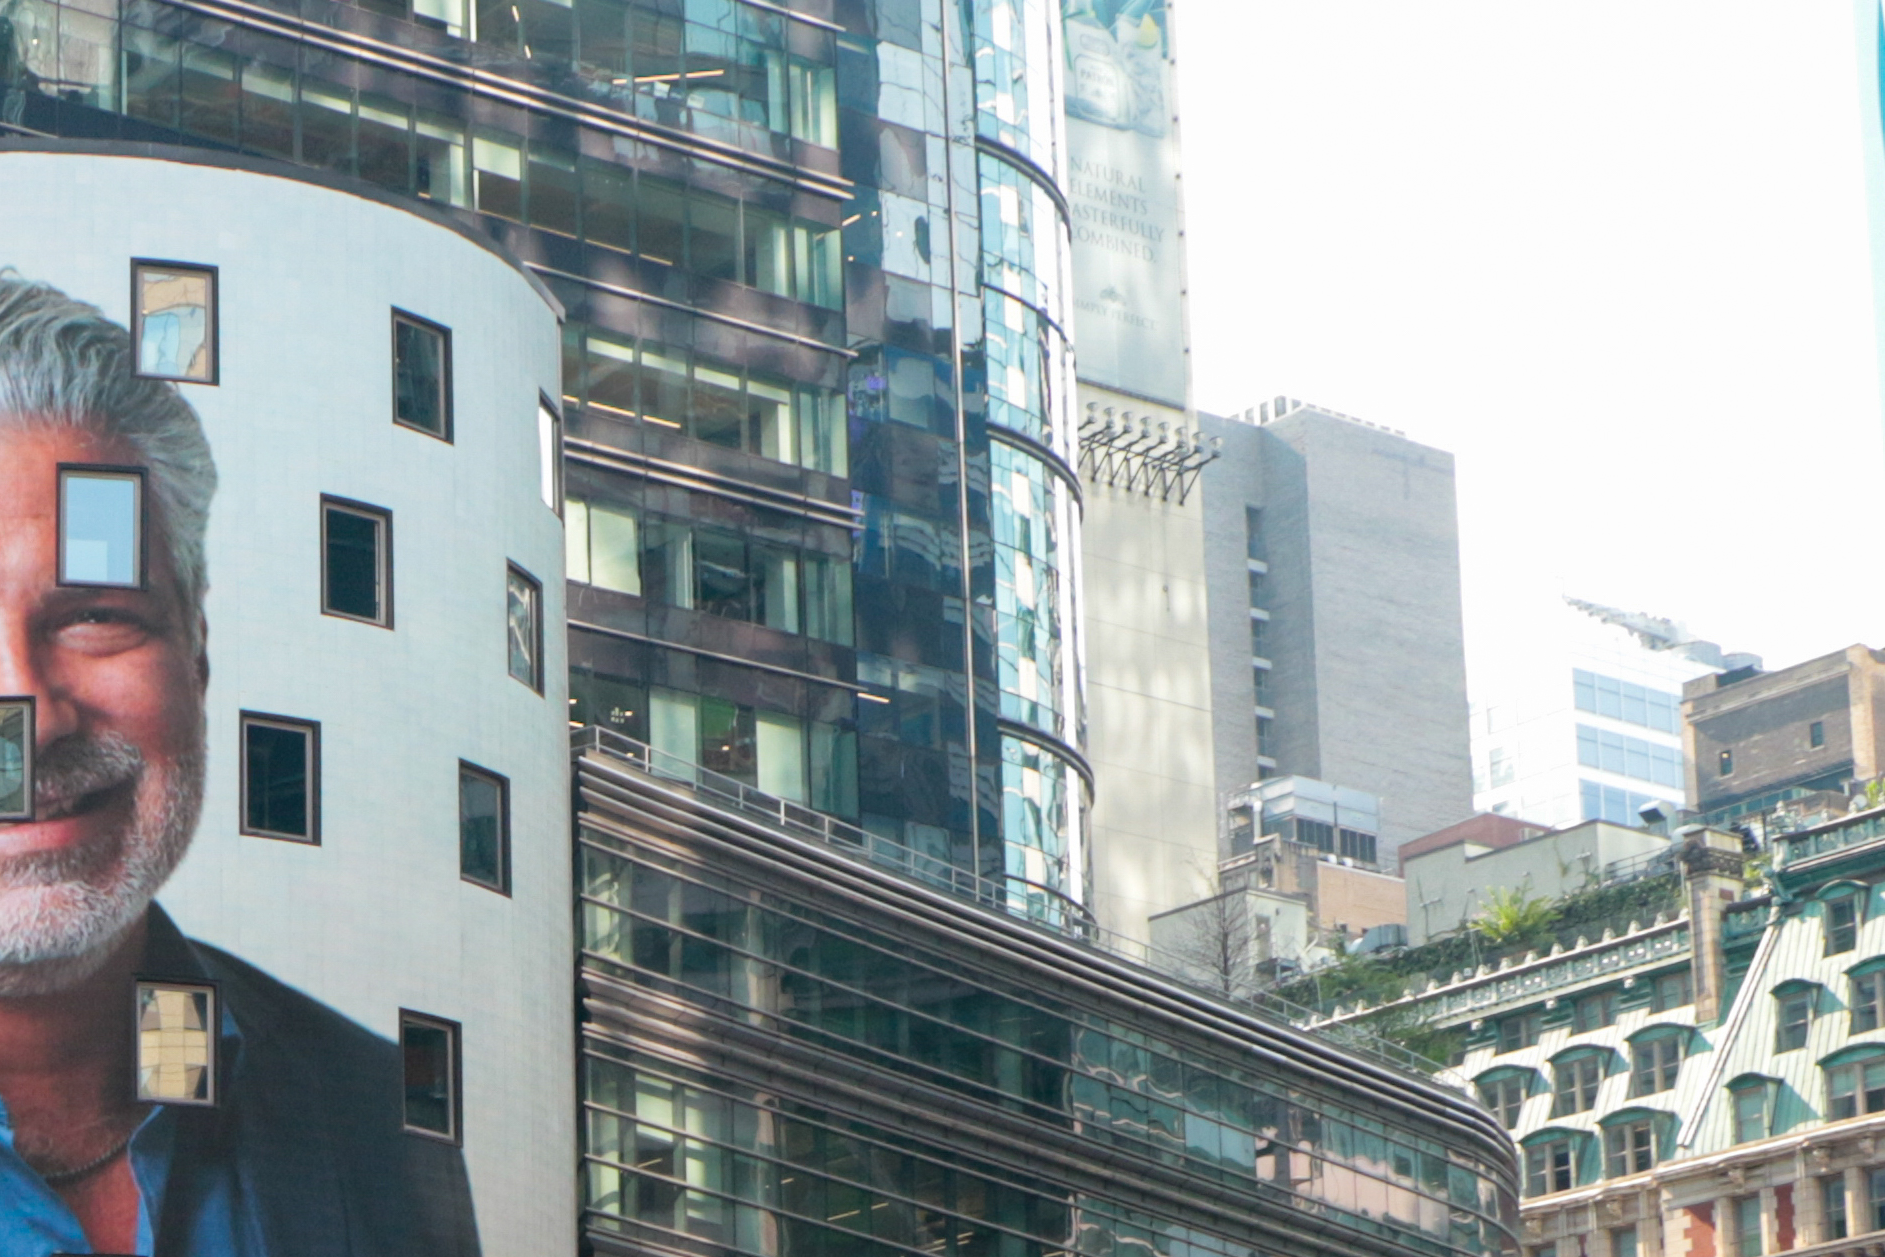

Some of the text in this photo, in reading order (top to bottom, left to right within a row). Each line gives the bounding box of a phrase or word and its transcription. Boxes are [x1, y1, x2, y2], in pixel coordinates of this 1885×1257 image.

[1070, 156, 1147, 193] NATURAL
[1069, 178, 1148, 215] ELEMENTS
[1072, 202, 1165, 243] ASTERFULLY
